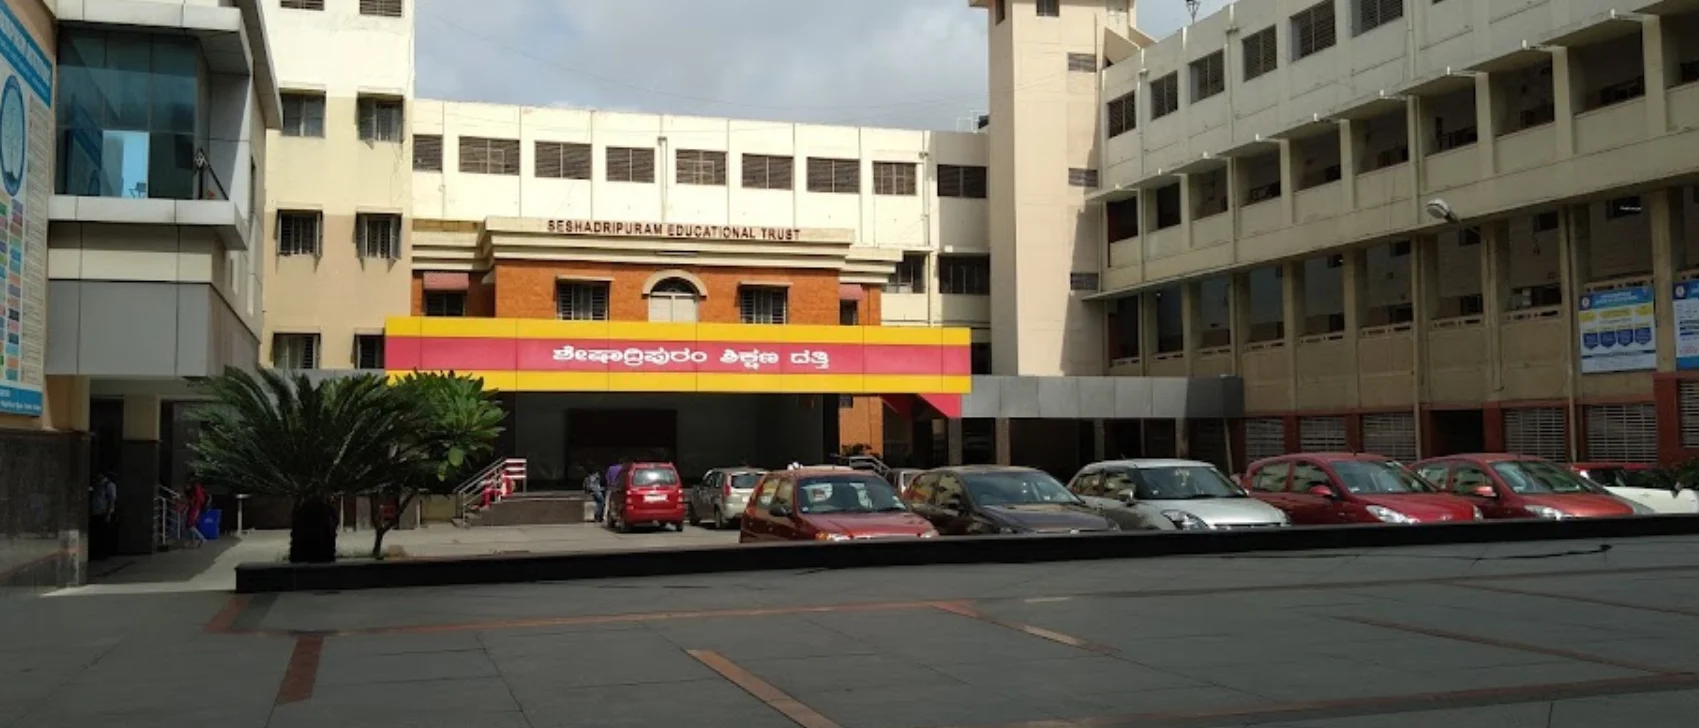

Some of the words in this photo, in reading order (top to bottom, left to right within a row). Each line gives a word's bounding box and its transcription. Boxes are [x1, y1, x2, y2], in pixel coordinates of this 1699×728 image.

[547, 219, 663, 235] SESHADRIPURAM
[667, 223, 756, 238] EDUCATIONAL
[761, 227, 801, 241] TRUST
[552, 344, 708, 367] ಶೇಷಾದ್ರಿಪುರಂ
[720, 348, 779, 370] ಶಿಕ್ಷಣ
[790, 349, 830, 370] ದತ್ತಿ
